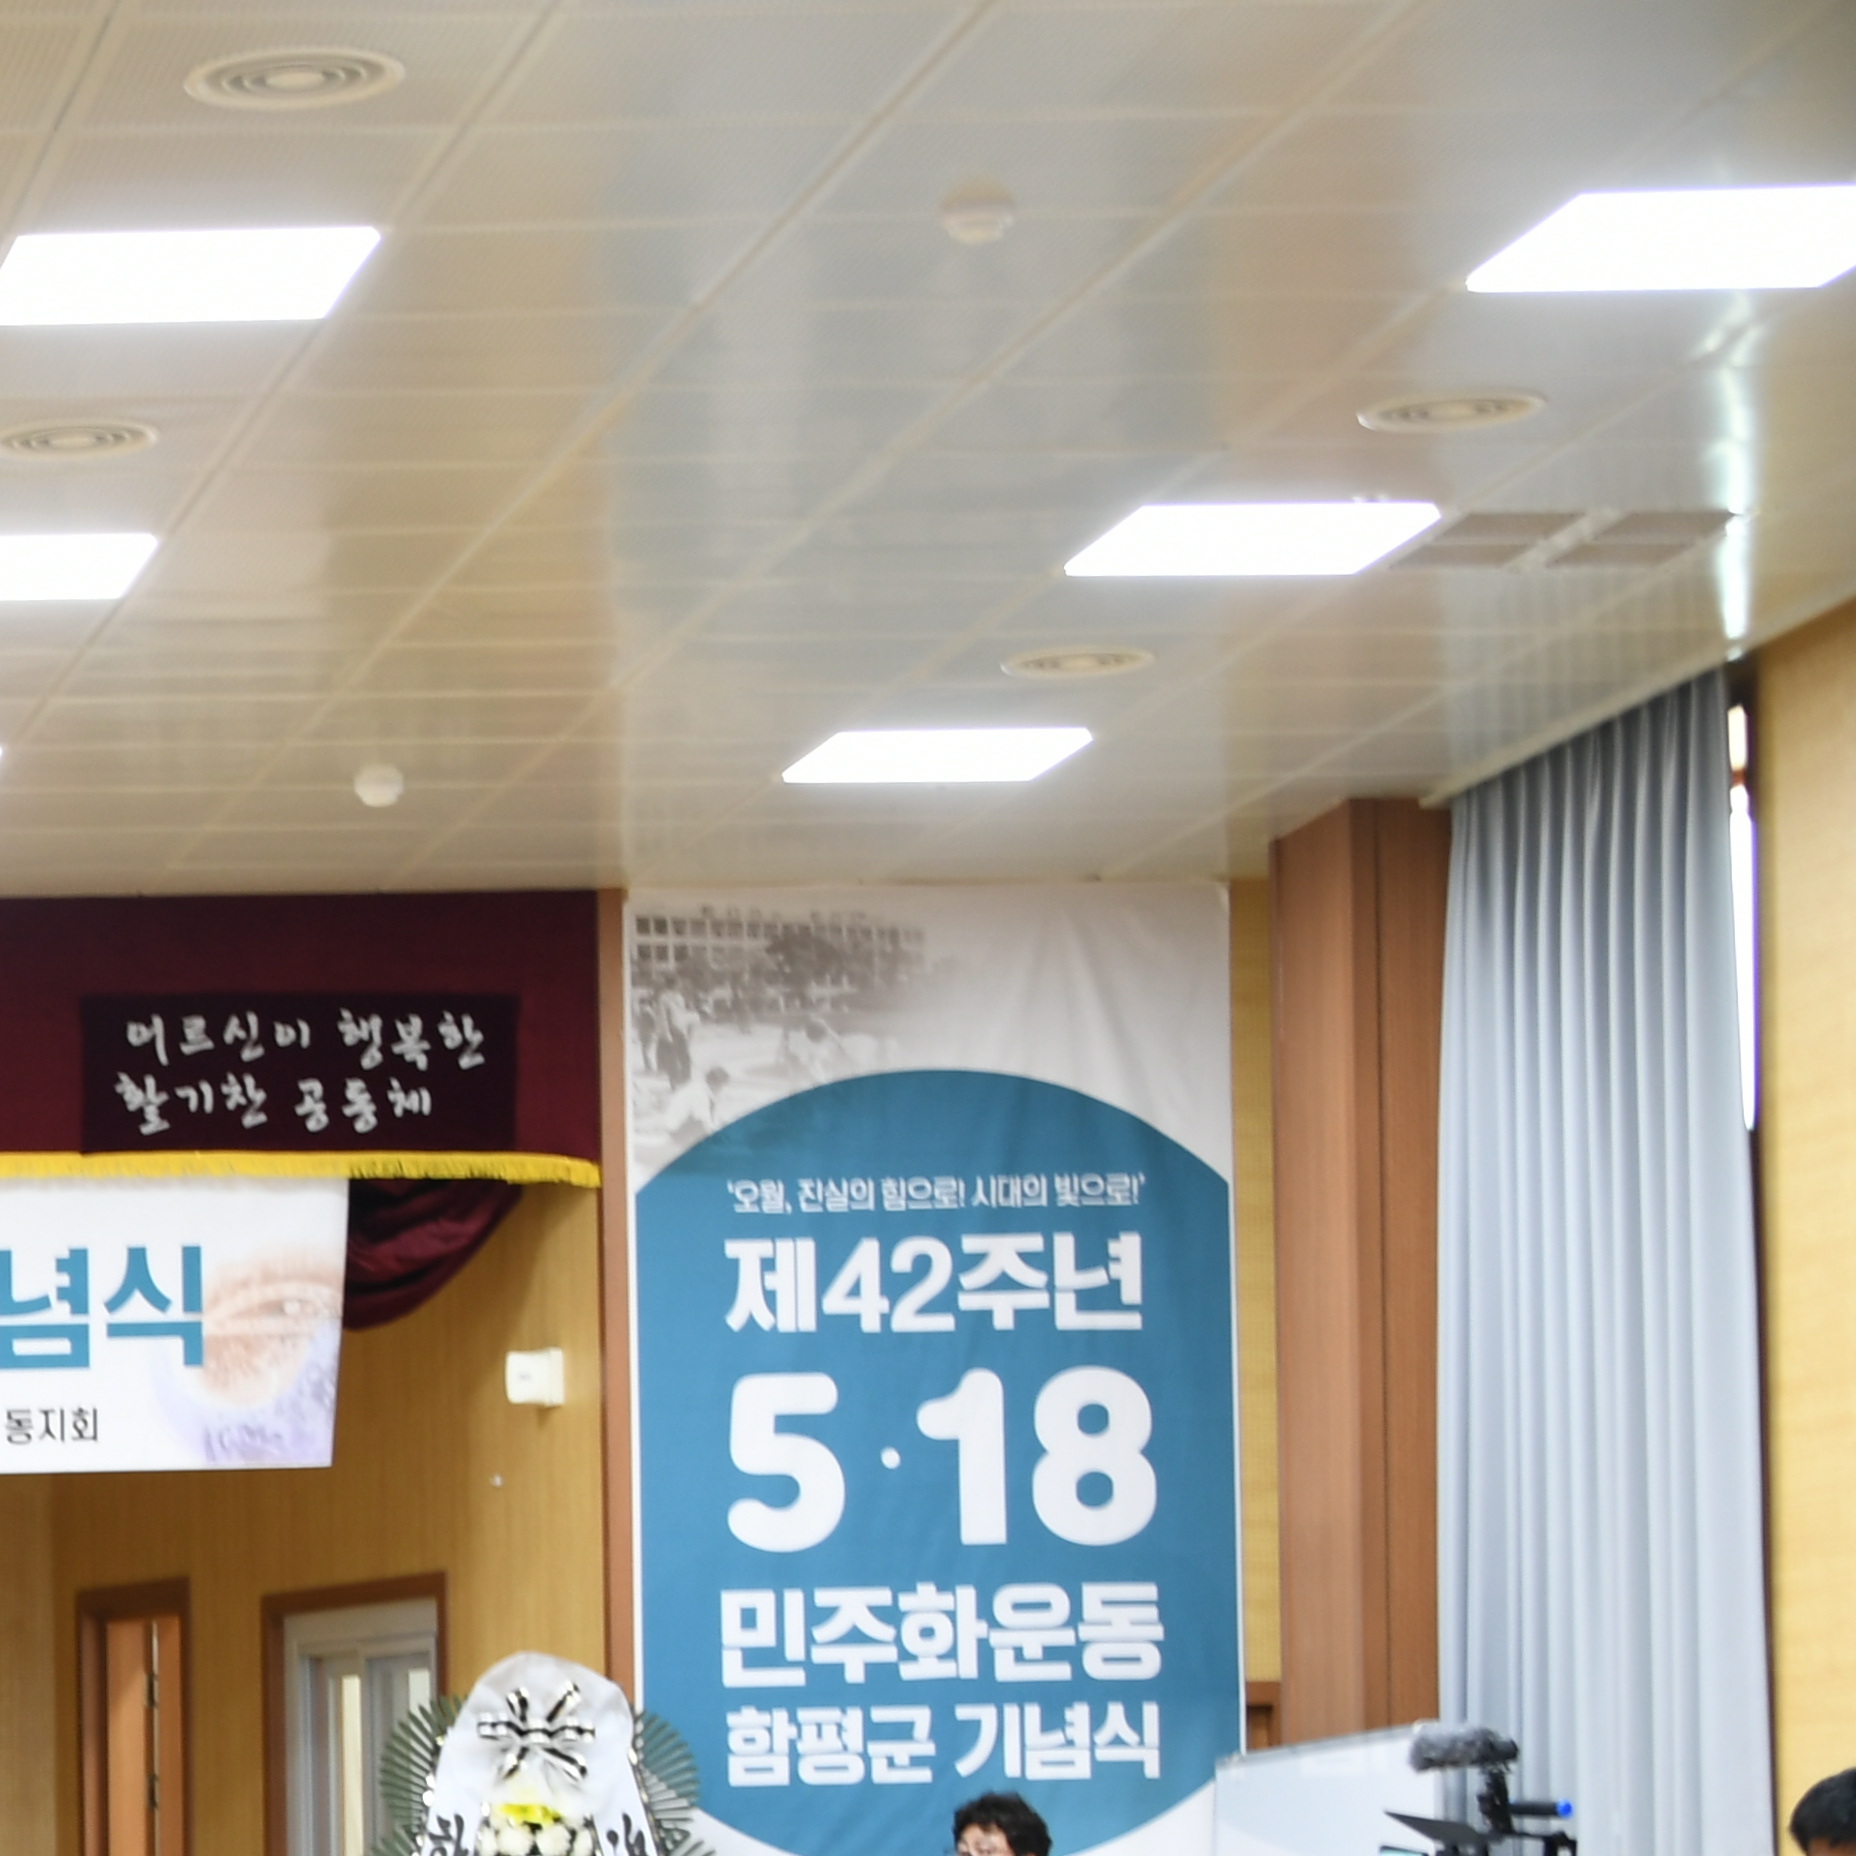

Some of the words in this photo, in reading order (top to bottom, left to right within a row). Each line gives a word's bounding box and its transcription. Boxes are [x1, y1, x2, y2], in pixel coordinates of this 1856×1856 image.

[337, 1008, 486, 1071] 행복한
[113, 1071, 269, 1136] 활기찬
[294, 1076, 433, 1134] 공동체
[796, 1177, 876, 1215] 진실의
[881, 1175, 966, 1212] 힘으로!
[970, 1173, 1049, 1209] 시대의
[723, 1231, 1144, 1334] 제42주년
[3, 1406, 101, 1446] 동지회
[720, 1581, 1166, 1689] 민주화운동
[725, 1705, 938, 1788] 함평군
[954, 1701, 1162, 1782] 기념식
